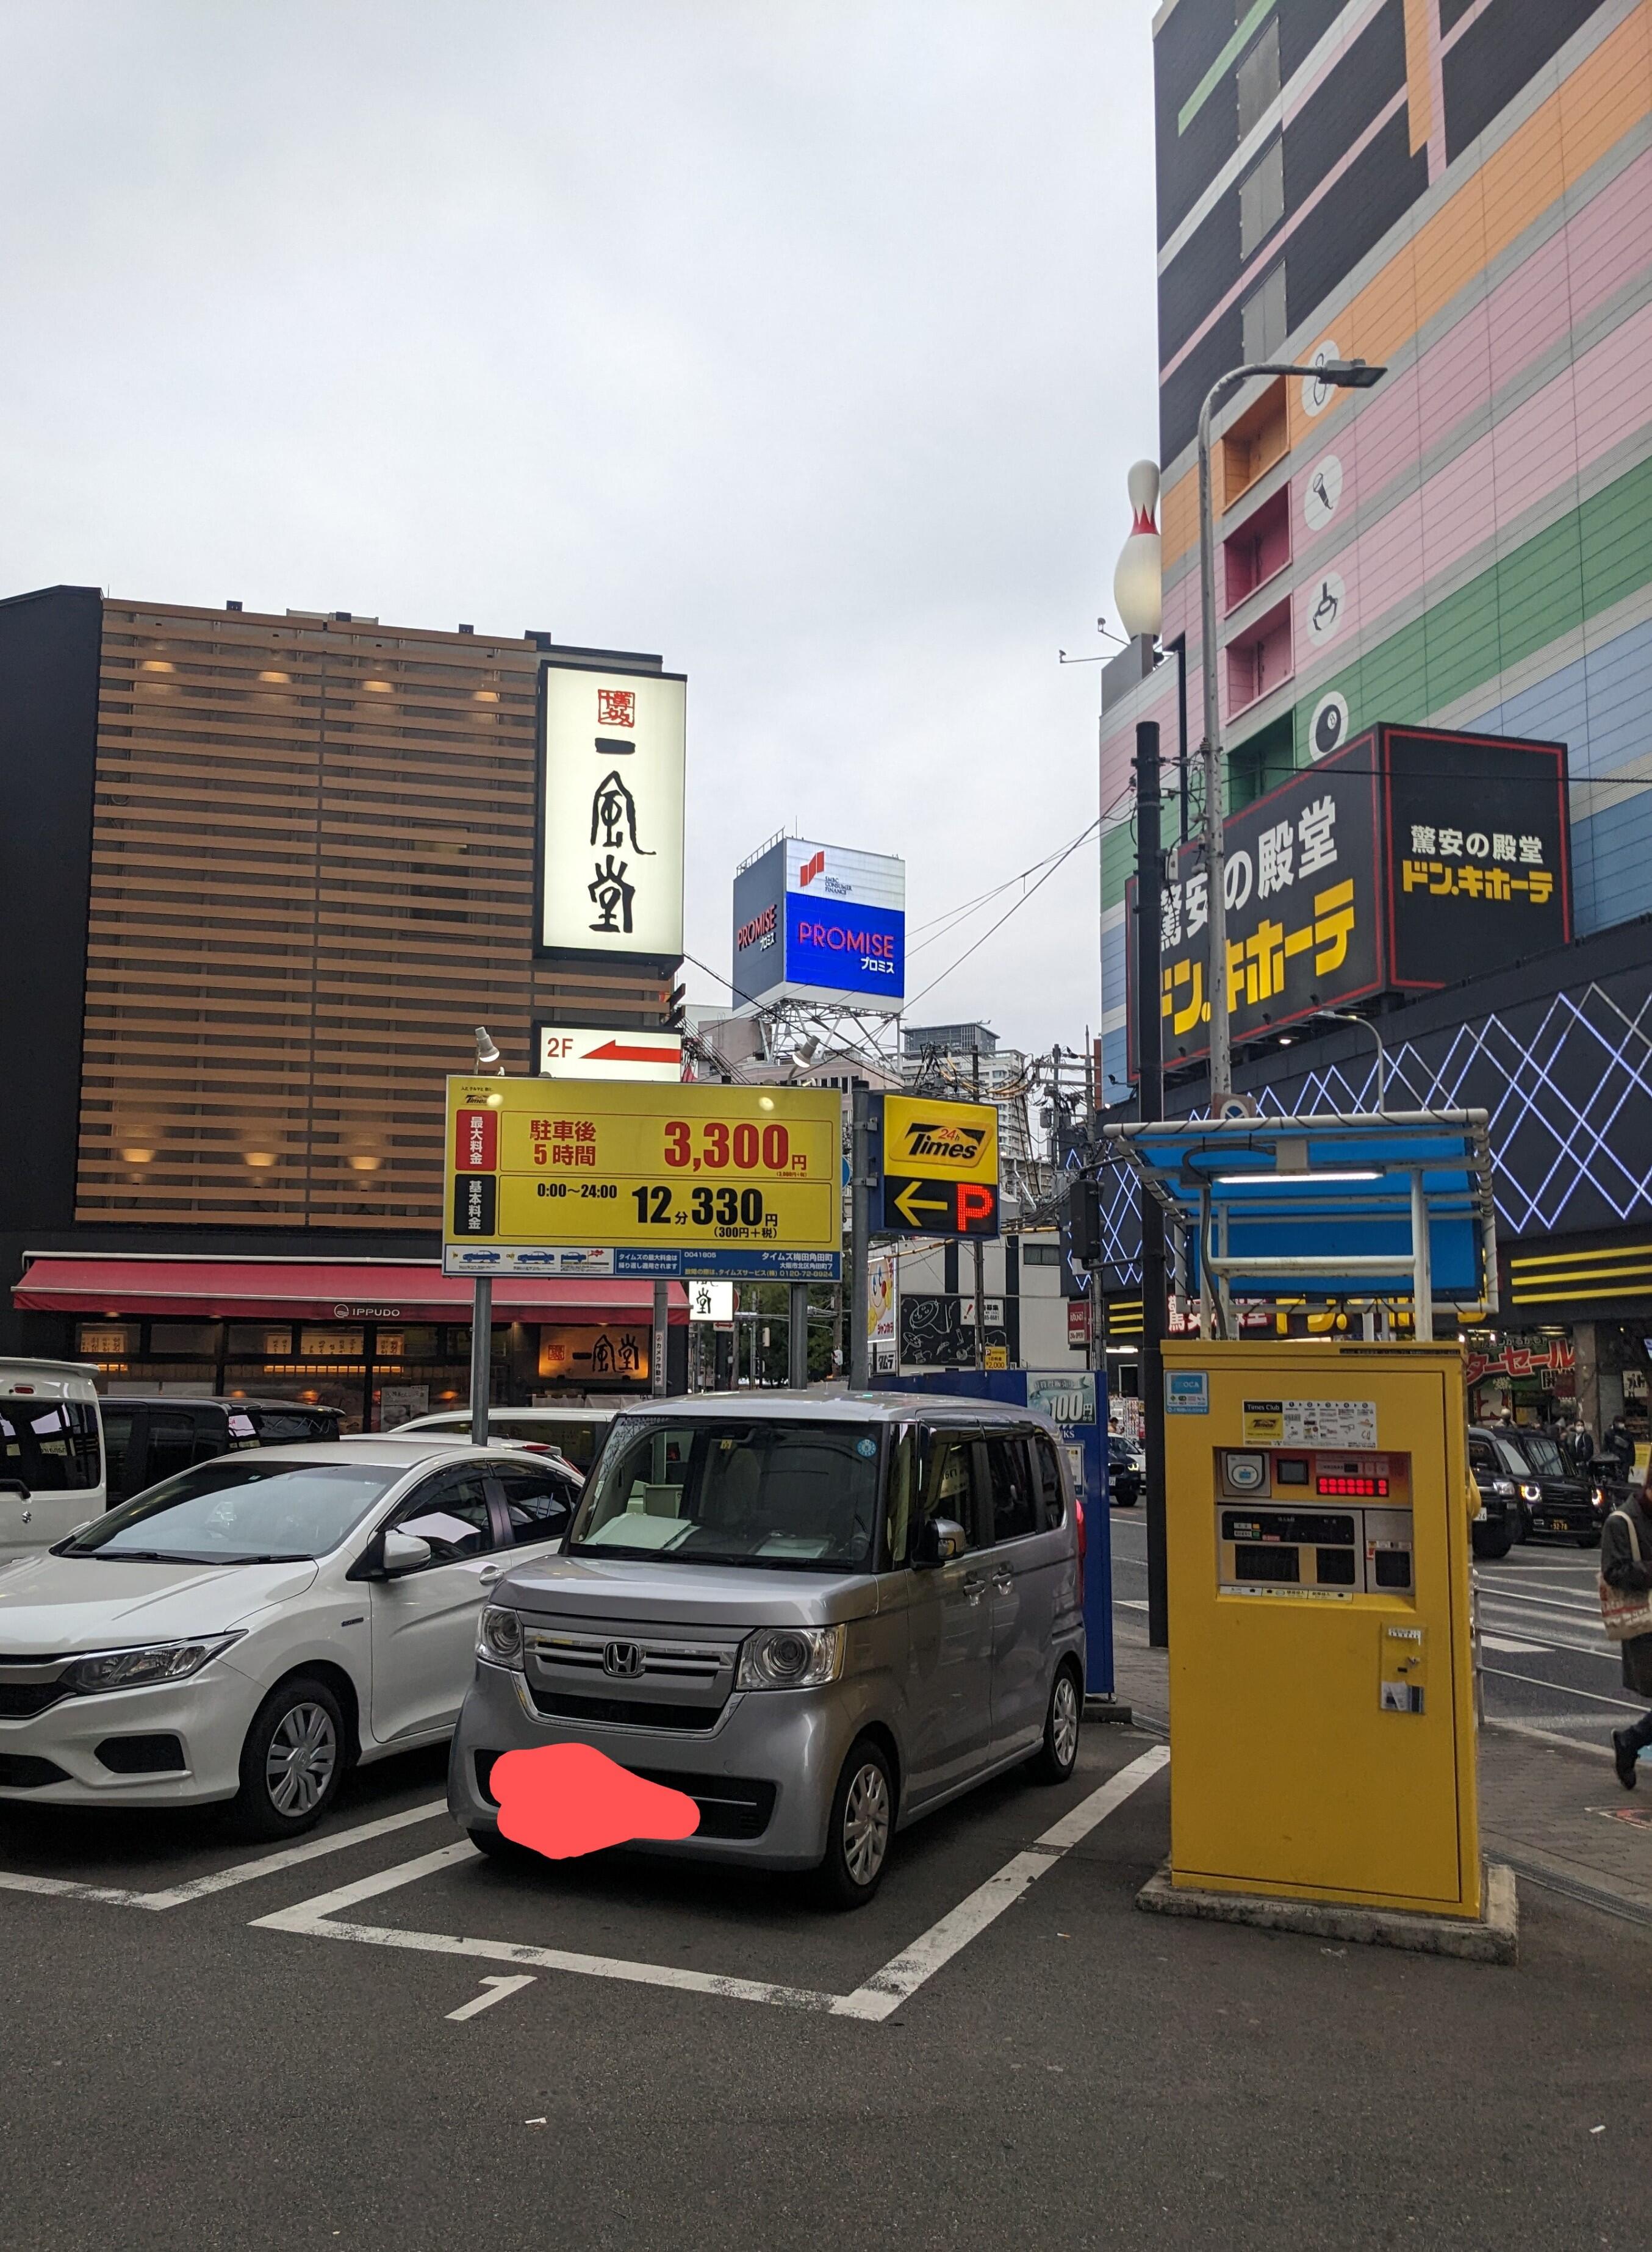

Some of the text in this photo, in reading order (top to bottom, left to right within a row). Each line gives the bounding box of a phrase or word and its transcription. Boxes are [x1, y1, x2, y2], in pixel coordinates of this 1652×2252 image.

[587, 737, 656, 934] 一風堂
[1410, 825, 1543, 864] 驚安の殿堂
[825, 882, 853, 891] CONSUMER
[825, 886, 847, 895] FINANCE
[737, 904, 777, 951] PROMISE
[799, 922, 895, 958] PROMISE
[760, 933, 775, 952] プロミス
[860, 957, 895, 974] プロミス
[547, 1038, 573, 1058] 2F
[470, 1116, 484, 1164] 最大料金
[530, 1119, 597, 1142] 駐車後
[938, 1128, 960, 1141] 24h
[906, 1130, 980, 1159] Times
[468, 1180, 482, 1230] 基本料金
[957, 1182, 993, 1232] P
[353, 1308, 400, 1317] IPPUDO
[877, 1322, 894, 1335] ジャンカラ
[444, 1974, 538, 2021] 1
